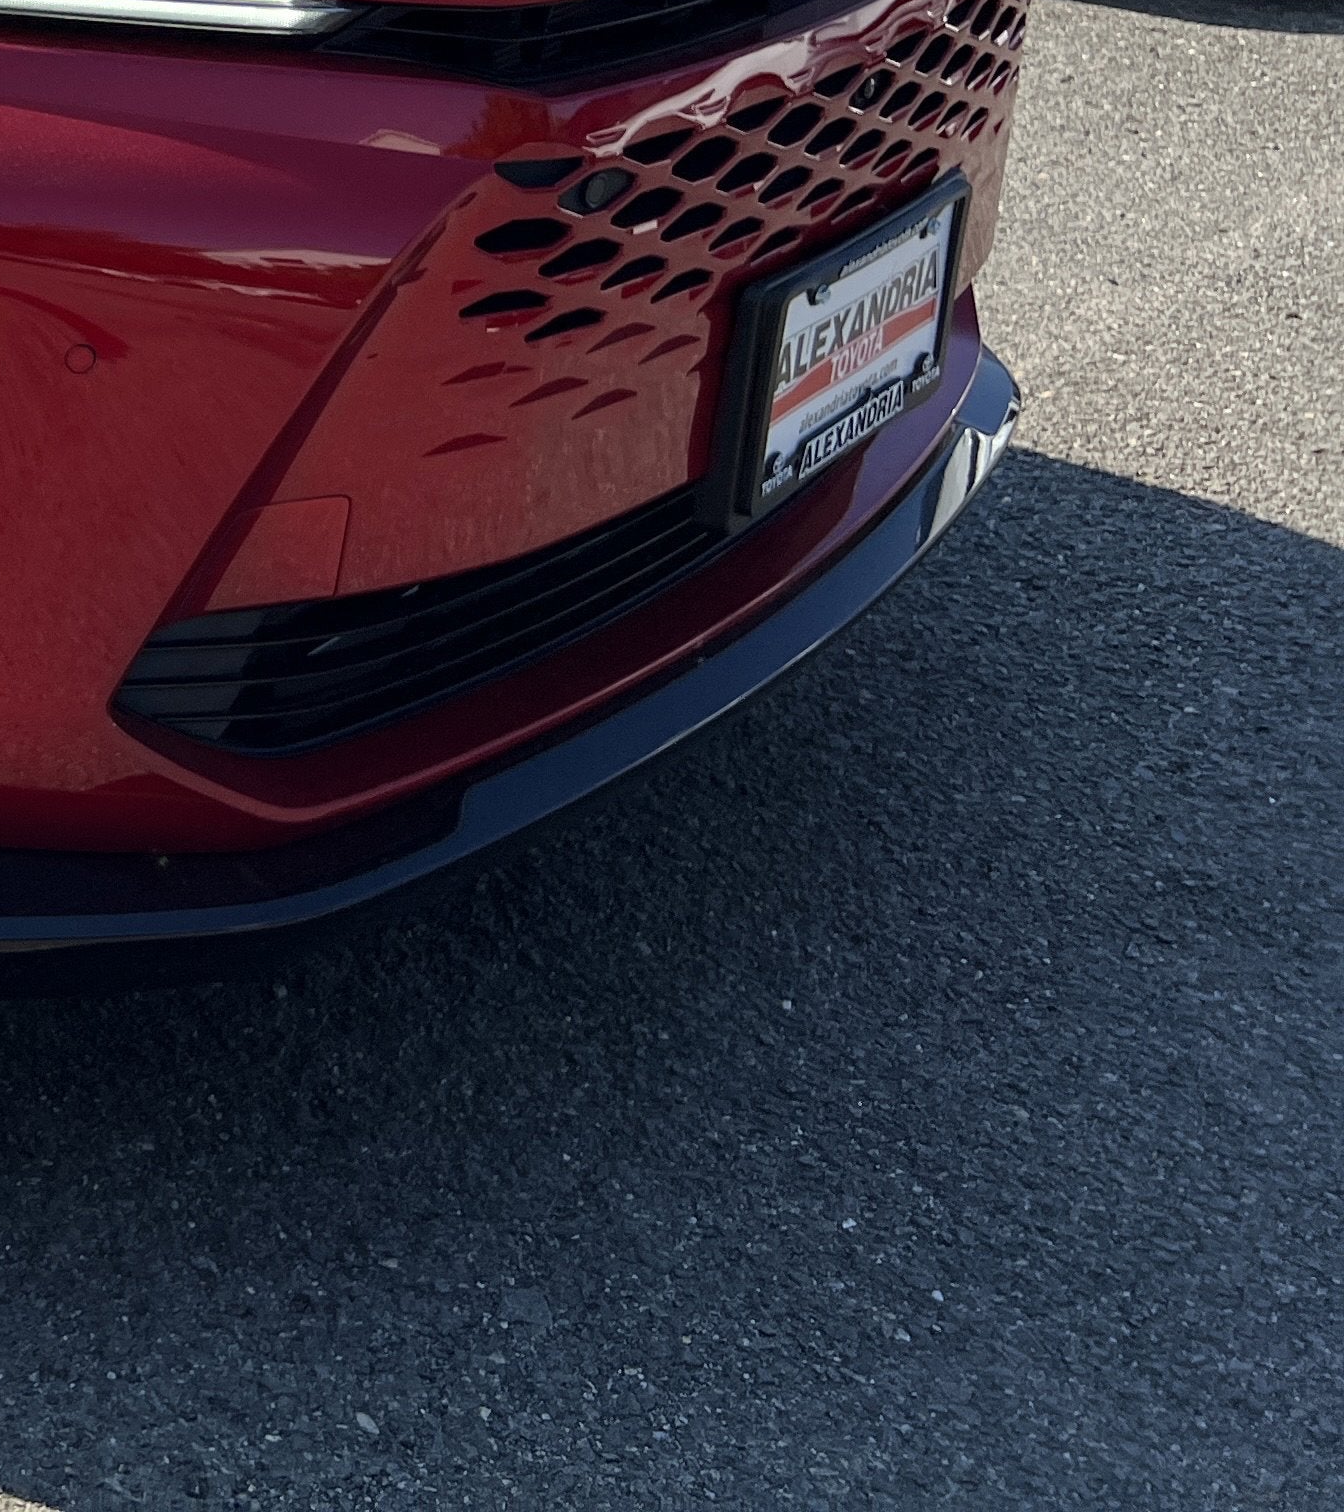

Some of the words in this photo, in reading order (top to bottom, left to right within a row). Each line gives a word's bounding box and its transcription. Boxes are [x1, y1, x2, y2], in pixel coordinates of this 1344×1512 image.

[776, 250, 938, 386] ALEXANDRIA
[830, 333, 884, 384] TOYOTA
[800, 382, 903, 477] ALEXANDRIA
